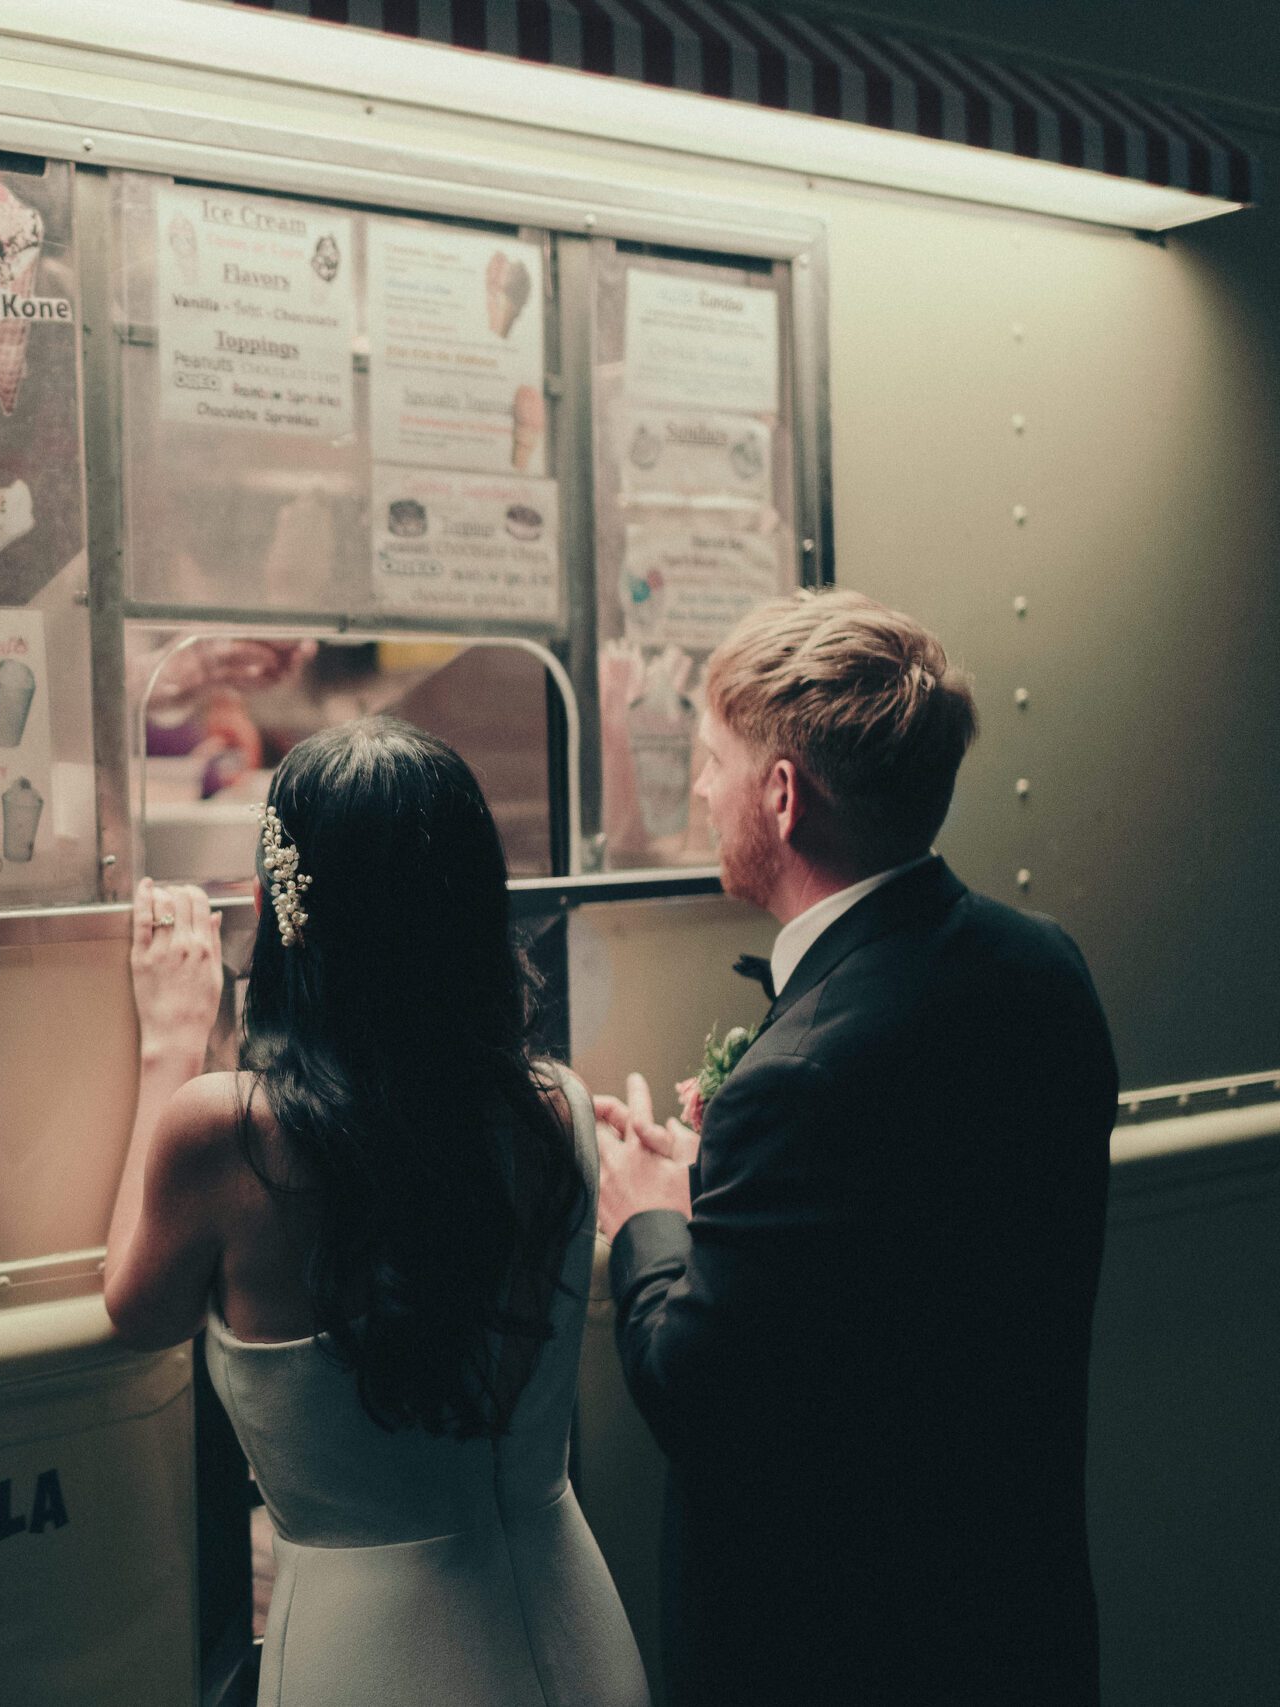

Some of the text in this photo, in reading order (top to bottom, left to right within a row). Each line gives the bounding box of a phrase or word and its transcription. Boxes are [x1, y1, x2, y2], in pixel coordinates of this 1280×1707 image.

[202, 200, 307, 235] Ice Cream
[223, 263, 290, 290] Flavors
[2, 294, 69, 319] Kone
[173, 293, 219, 312] Vanilla
[216, 330, 299, 360] Toppings
